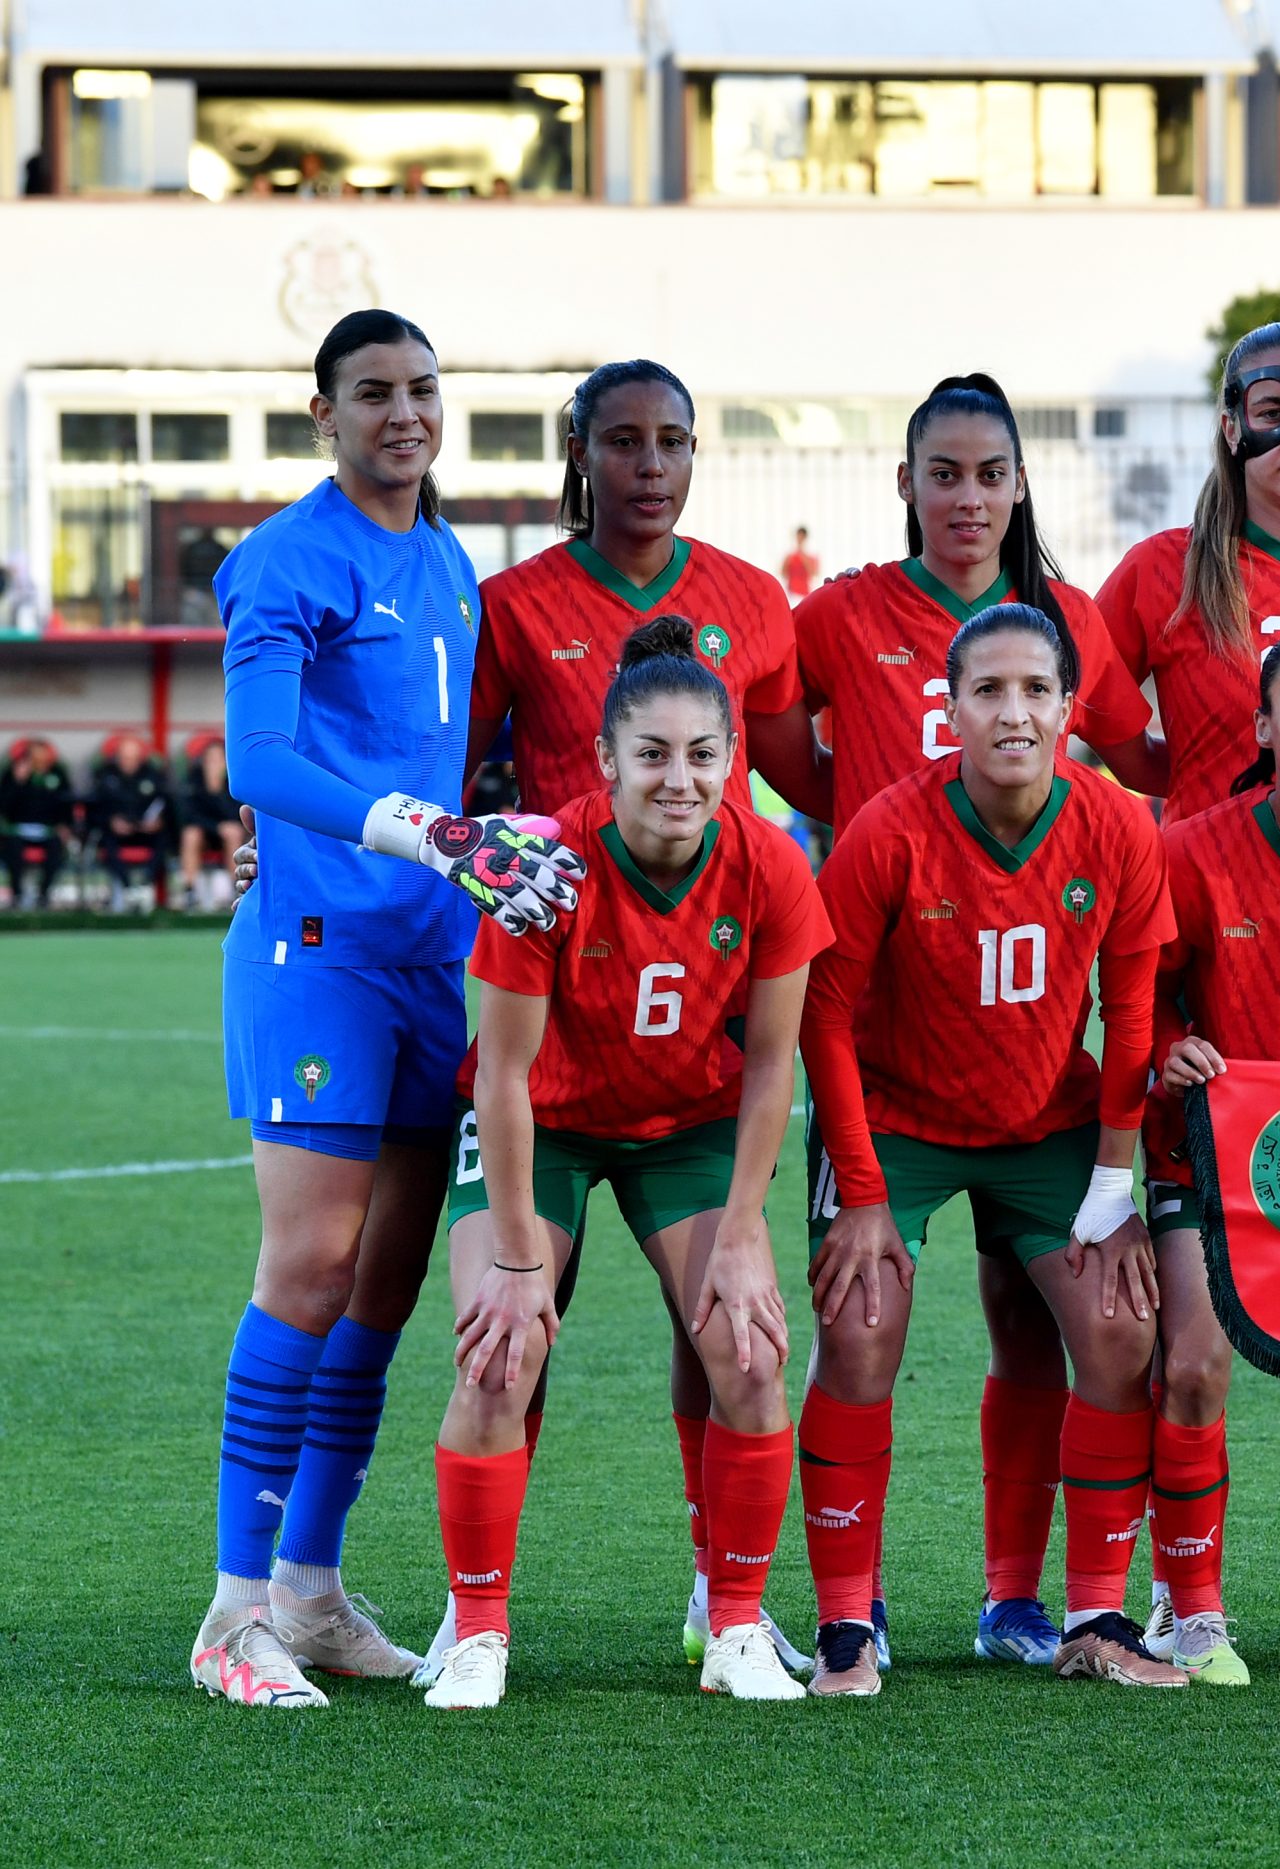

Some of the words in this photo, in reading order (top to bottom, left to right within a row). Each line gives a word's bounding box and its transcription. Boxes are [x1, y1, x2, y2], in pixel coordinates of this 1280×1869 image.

[551, 649, 585, 661] PUMA
[877, 653, 909, 665] PUMA
[433, 636, 450, 724] 1
[920, 908, 954, 920] PUMA
[1222, 926, 1256, 938] PUMA
[978, 923, 1045, 1006] 10
[633, 962, 686, 1037] 6
[806, 1512, 850, 1529] PUMA
[1159, 1543, 1206, 1557] PUMA
[456, 1571, 496, 1585] PUMA
